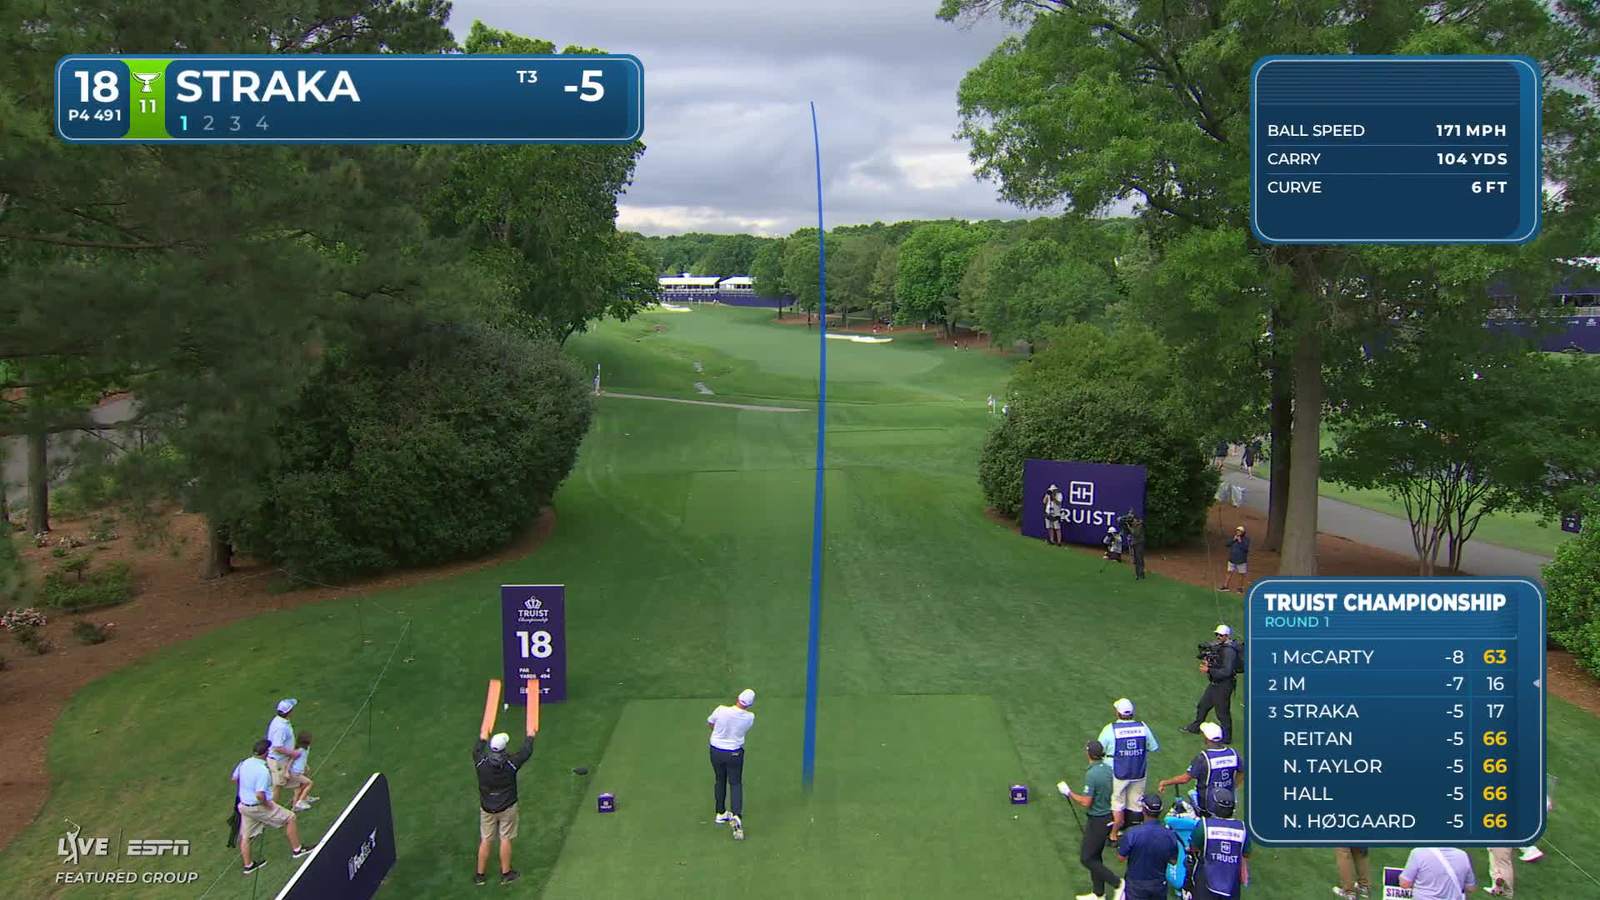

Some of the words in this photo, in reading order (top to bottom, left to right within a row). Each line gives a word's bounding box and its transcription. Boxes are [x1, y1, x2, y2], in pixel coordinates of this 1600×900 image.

[1060, 507, 1115, 526] RUIST
[518, 609, 549, 617] TRUIST
[516, 630, 552, 658] 18
[1211, 853, 1239, 864] TRUIST
